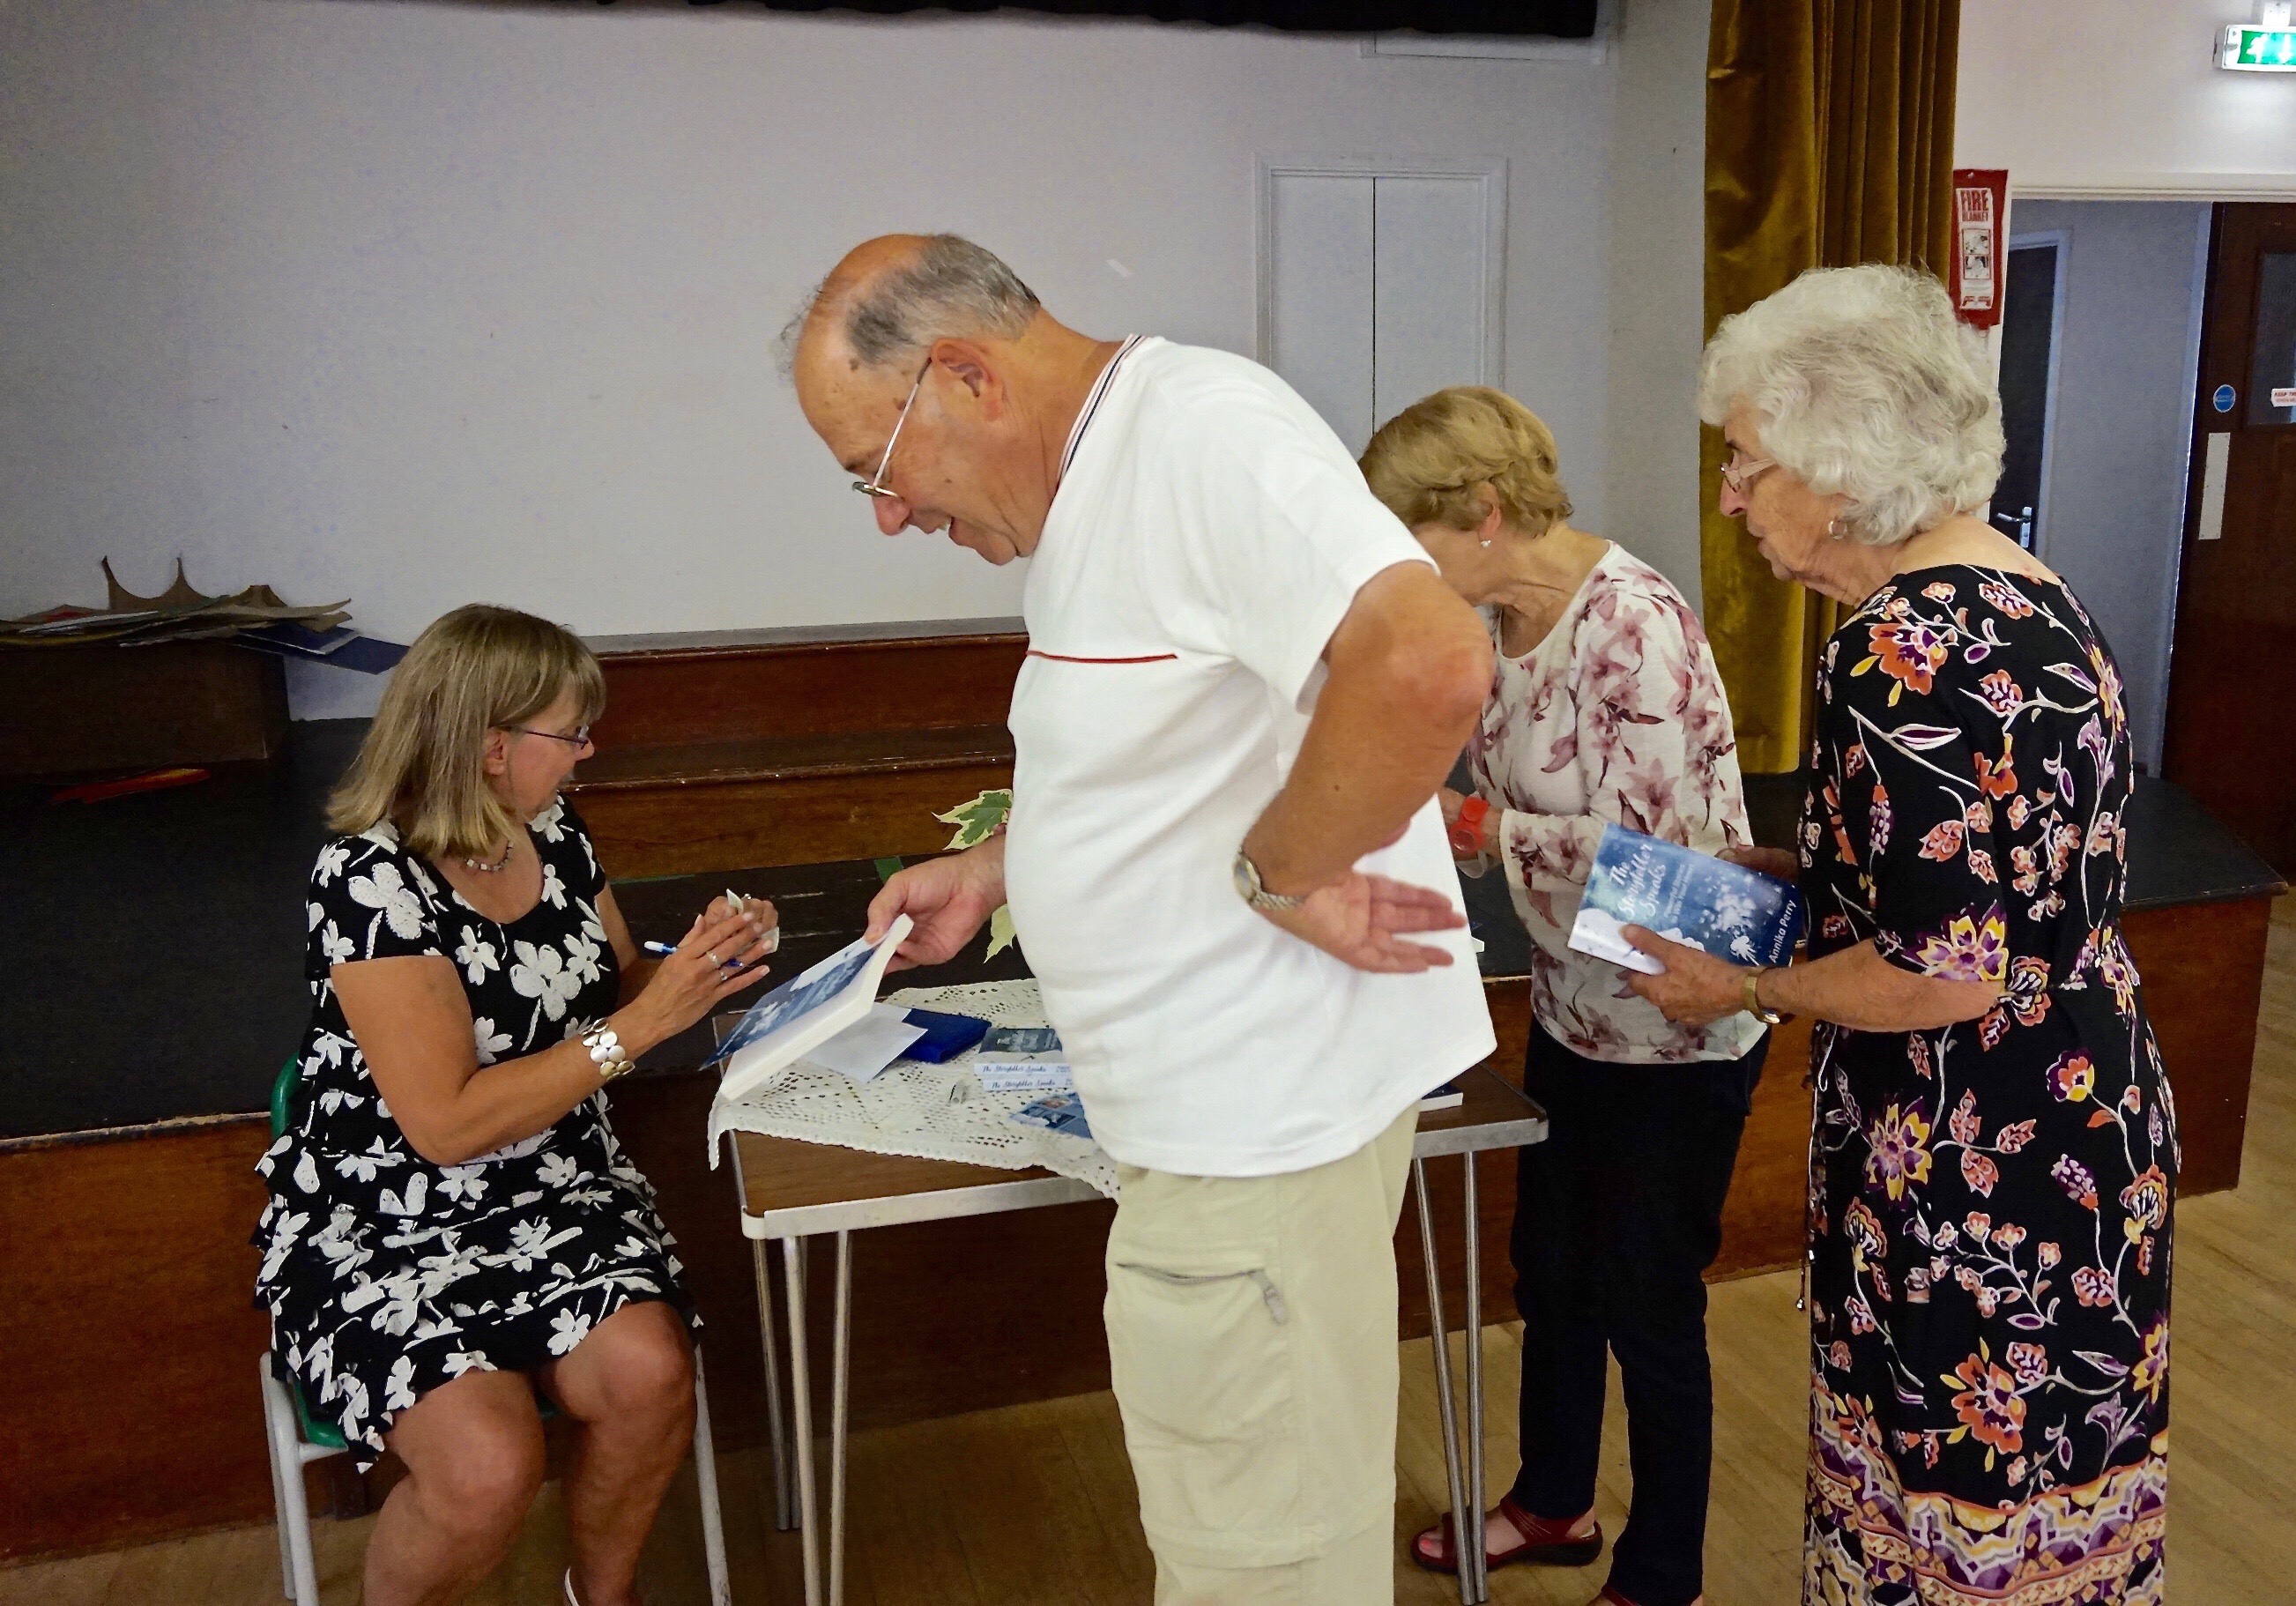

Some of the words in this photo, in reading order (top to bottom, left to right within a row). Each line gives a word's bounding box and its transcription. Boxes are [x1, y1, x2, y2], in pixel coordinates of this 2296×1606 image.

[1960, 190, 1988, 211] FIRE
[1609, 862, 1630, 886] The
[1617, 844, 1653, 920] Storyteller
[1638, 864, 1666, 920] Speaks
[1768, 927, 1787, 963] Annika
[1779, 899, 1796, 927] Perry
